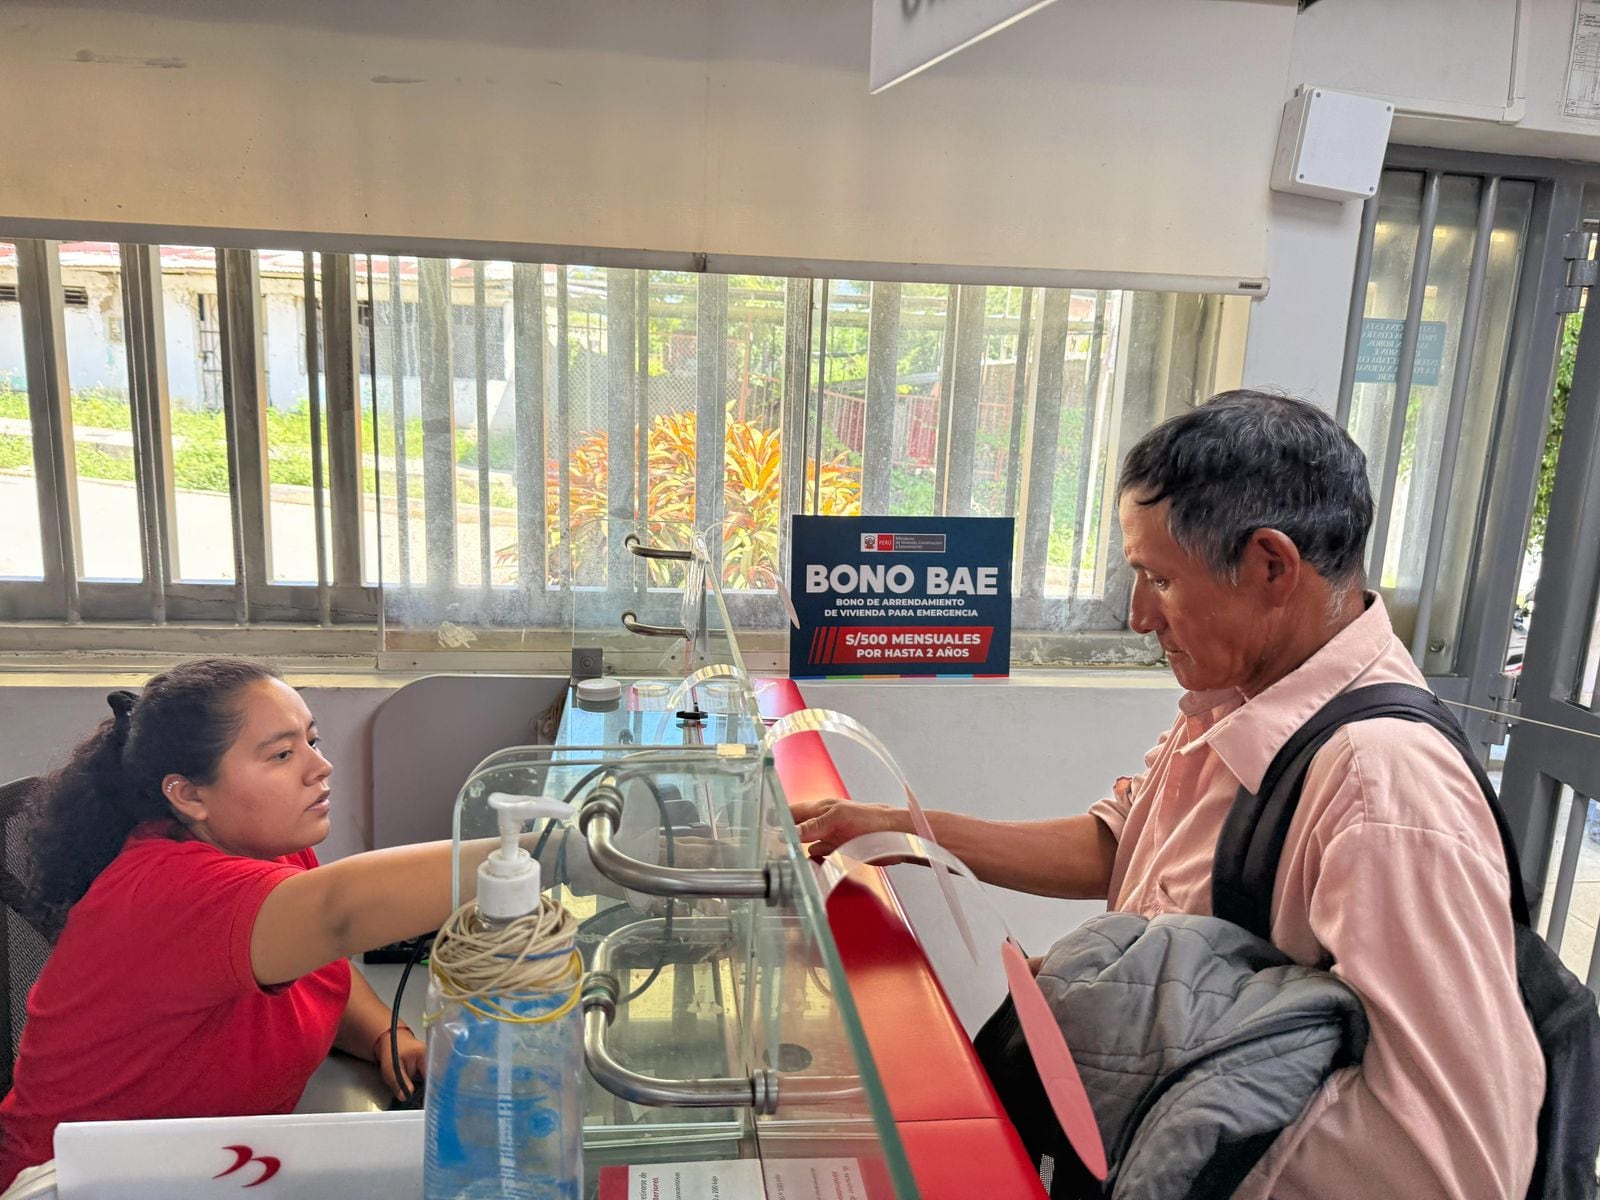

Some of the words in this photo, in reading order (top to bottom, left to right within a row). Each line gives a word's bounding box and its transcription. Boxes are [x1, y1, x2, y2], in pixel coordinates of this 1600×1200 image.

[806, 564, 915, 594] BONO
[926, 566, 998, 595] BAE
[836, 598, 865, 606] BONO
[866, 598, 880, 606] DE
[881, 598, 965, 606] ARRENDAMIENTO
[824, 609, 838, 617] DE
[839, 609, 886, 617] VIVIENDA
[888, 609, 915, 617] PARA
[916, 609, 978, 617] EMERGENCIA
[845, 632, 888, 646] S/500
[891, 633, 981, 645] MENSUALES
[857, 648, 882, 658] POR
[884, 648, 924, 658] HASTA
[926, 648, 934, 657] 2
[936, 646, 970, 658] AÑOS
